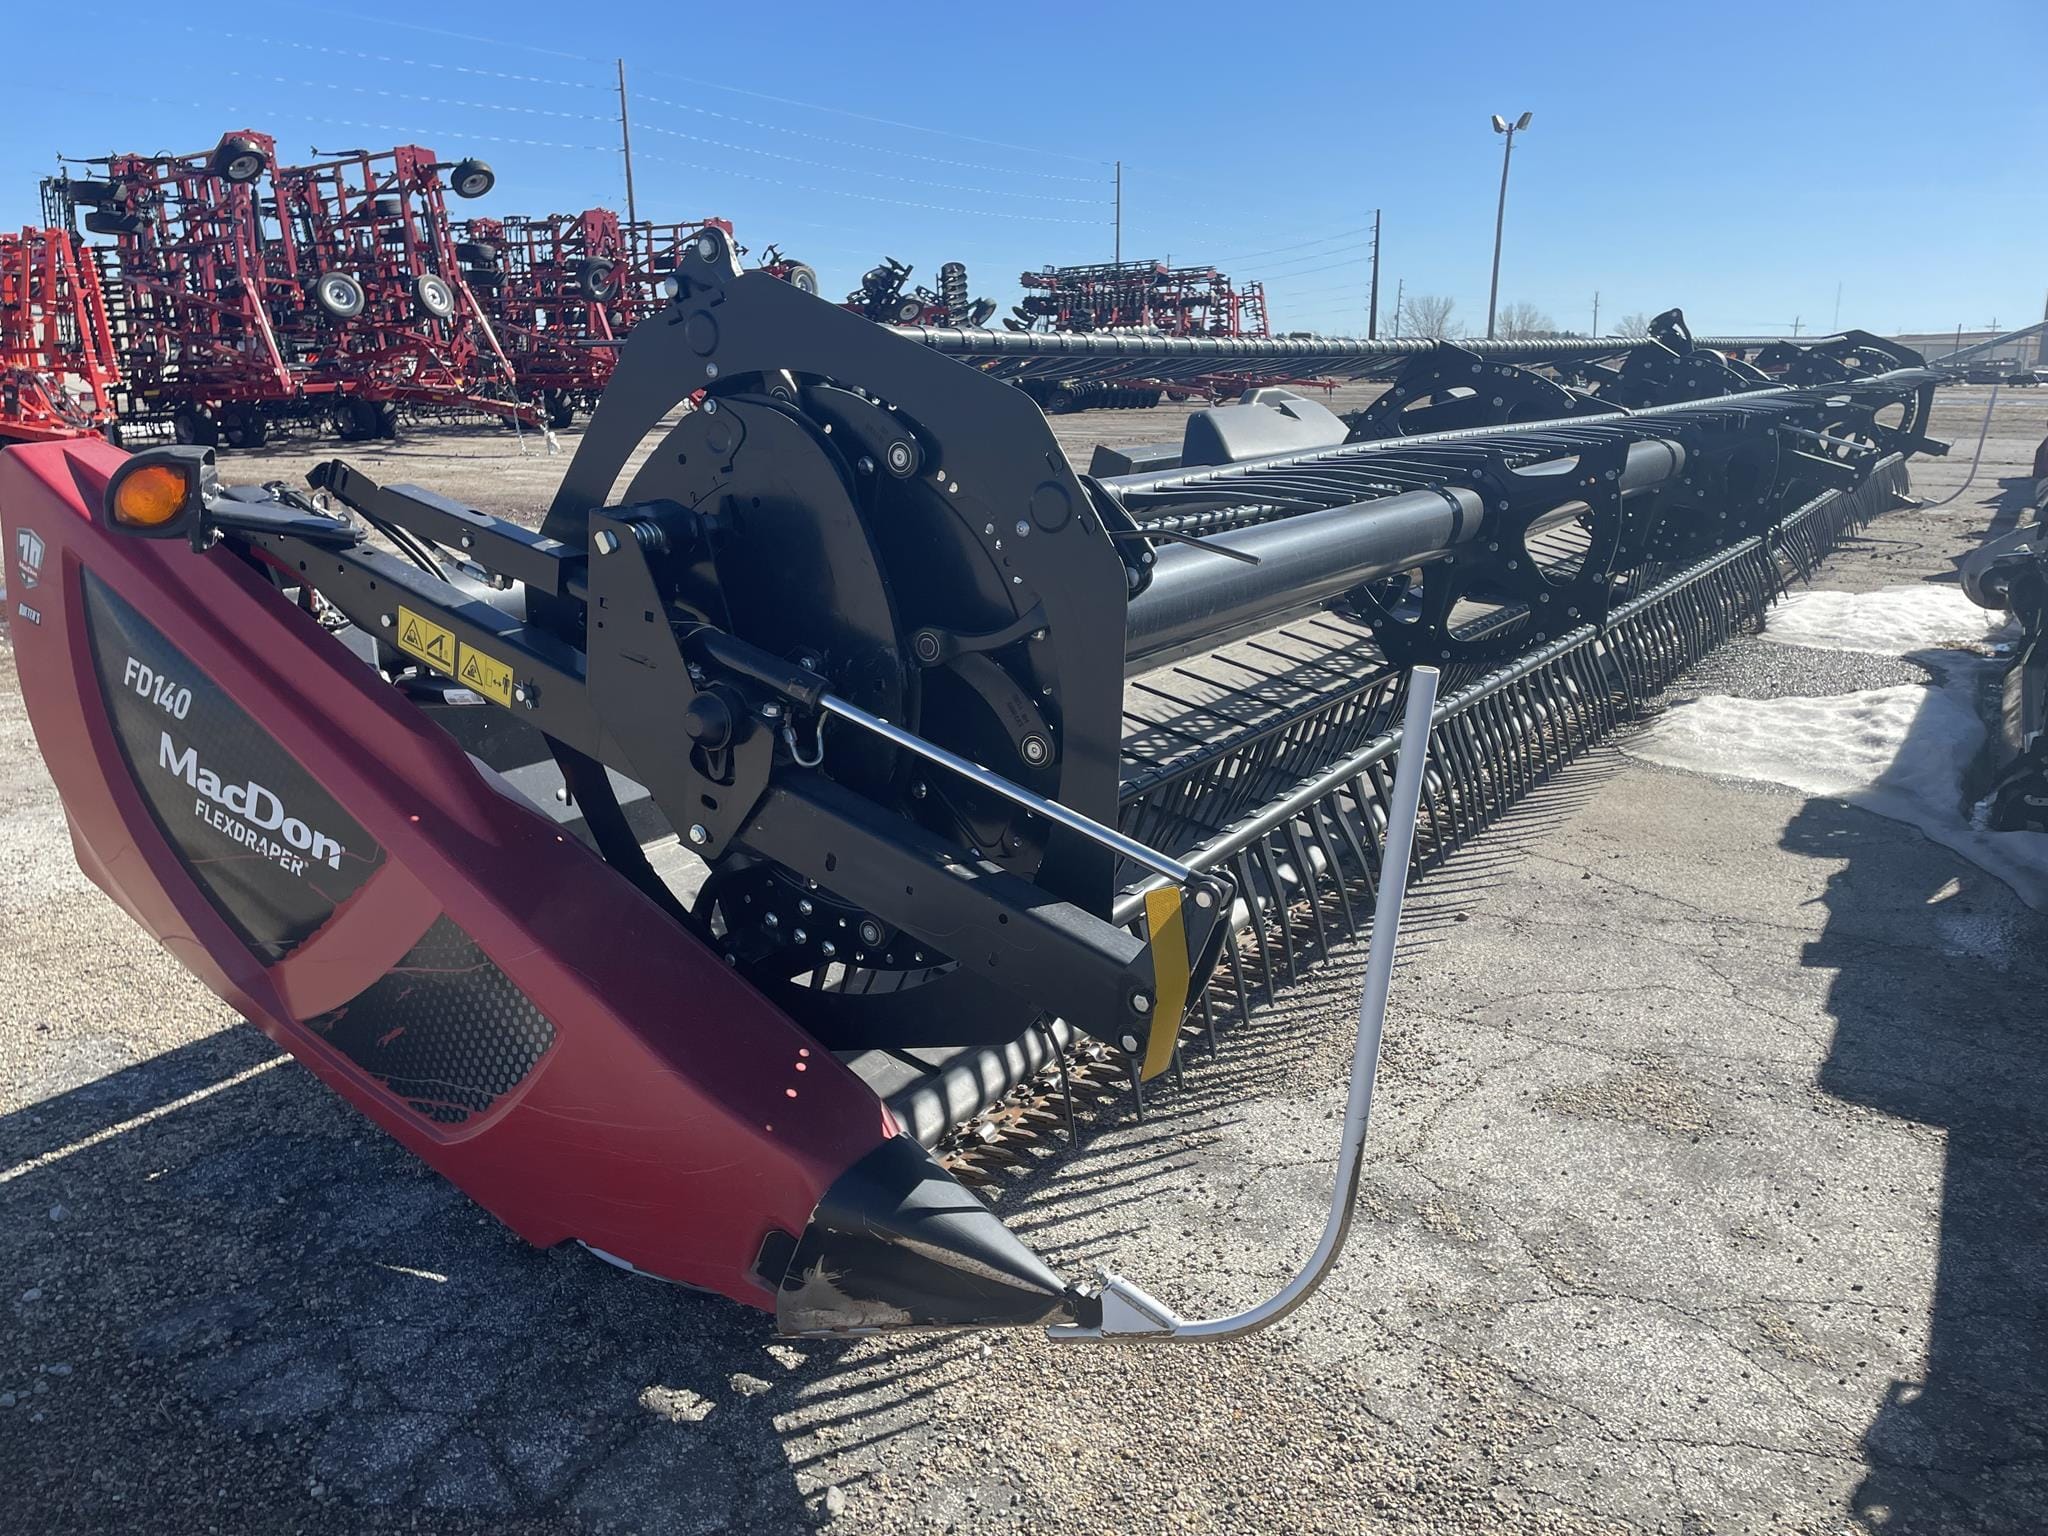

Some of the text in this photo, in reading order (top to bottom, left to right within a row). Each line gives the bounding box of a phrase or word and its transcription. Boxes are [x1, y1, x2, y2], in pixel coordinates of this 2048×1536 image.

[123, 656, 192, 720] FD140
[159, 731, 343, 870] MacDon
[195, 798, 304, 877] FLEXDRAPER
